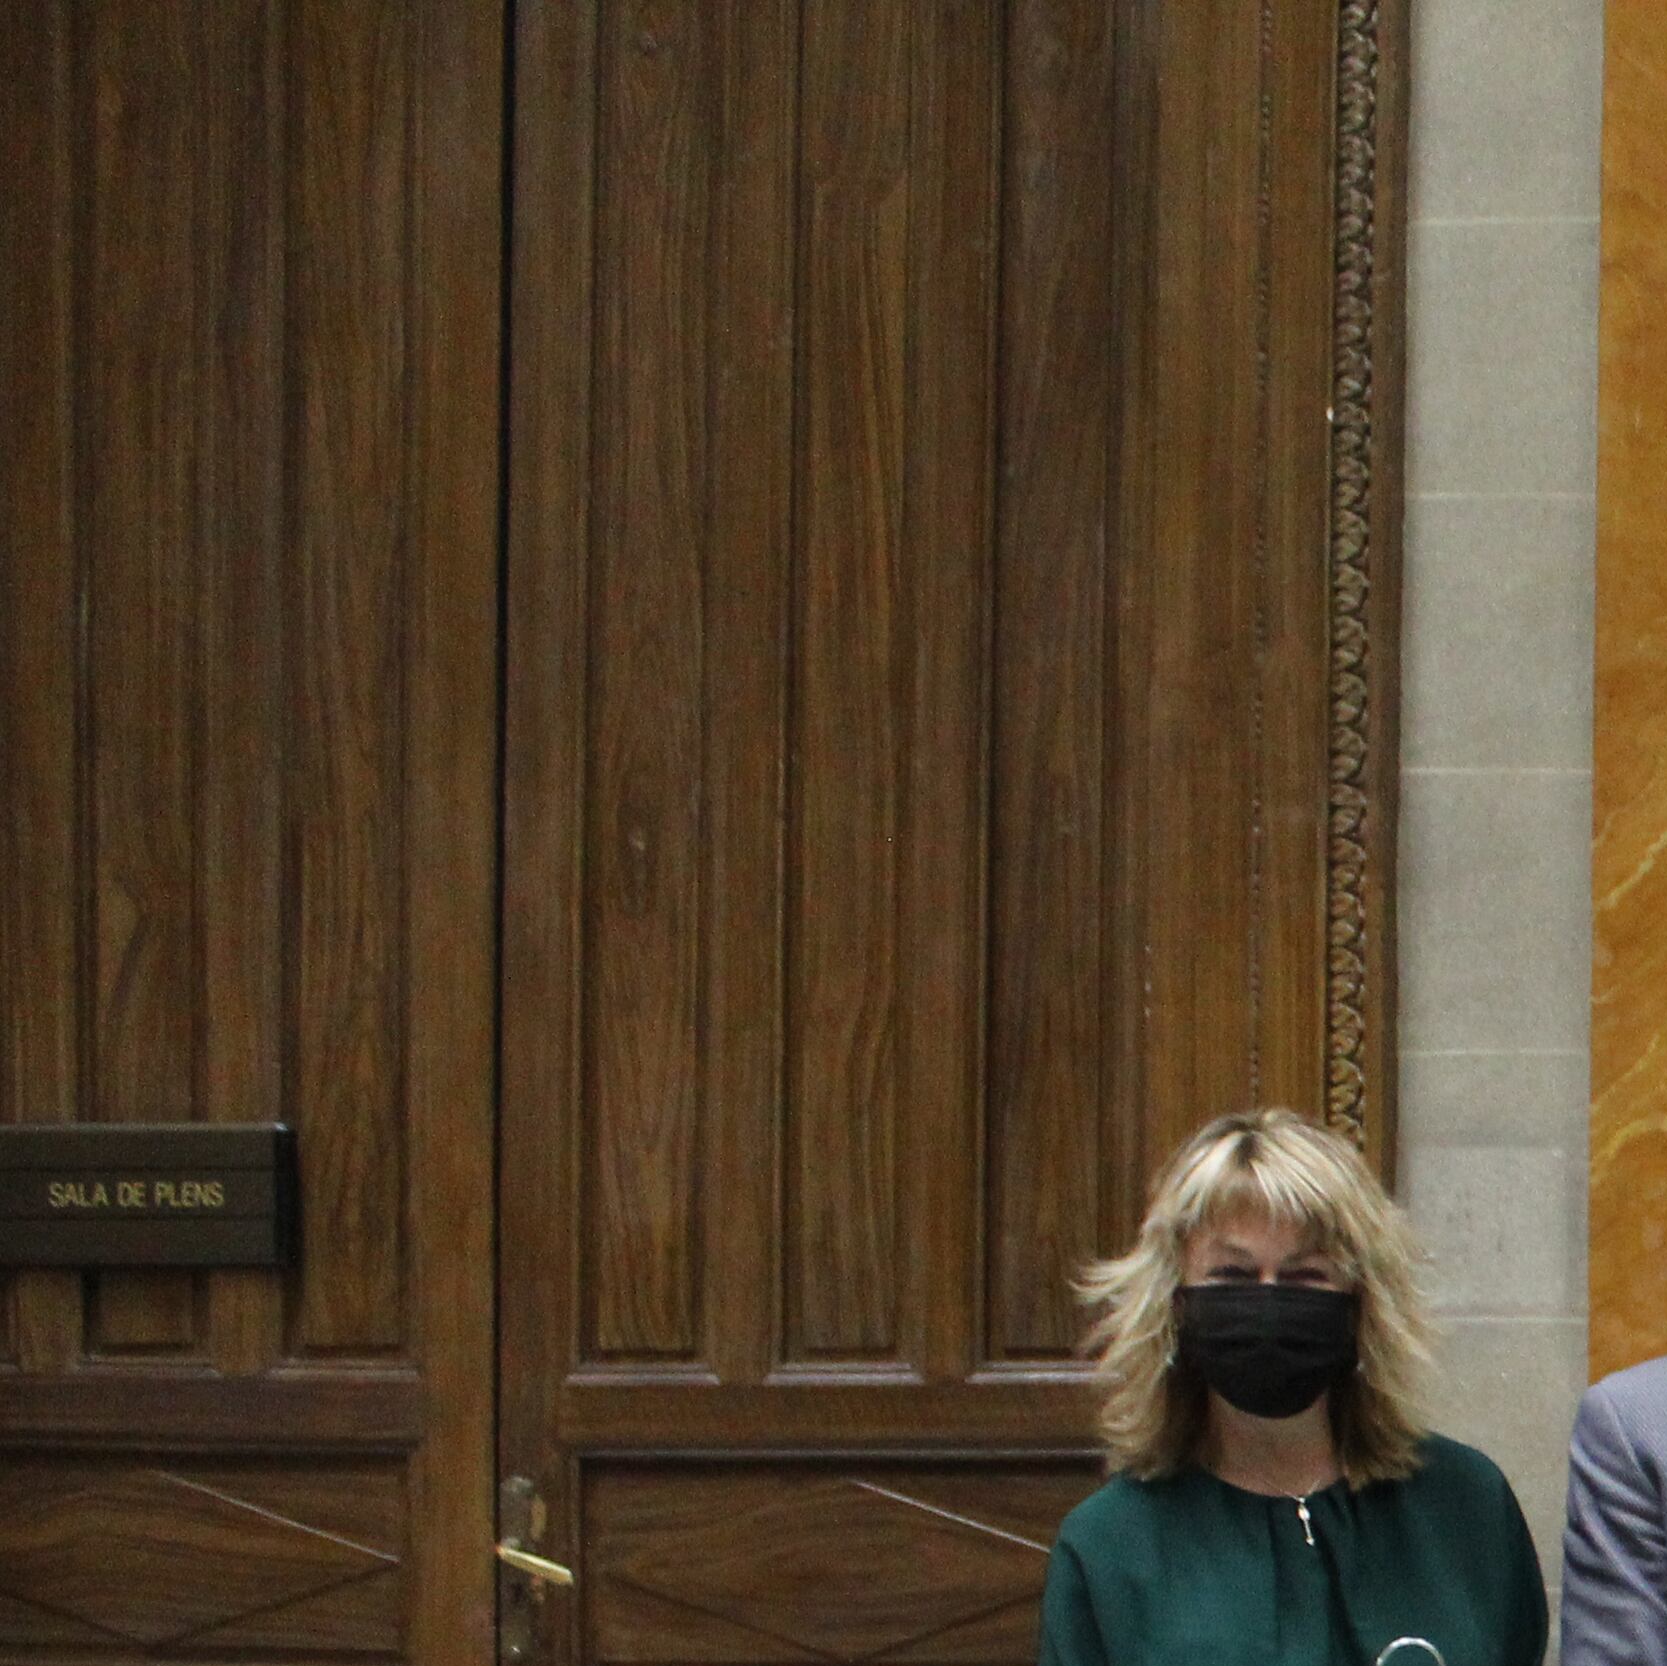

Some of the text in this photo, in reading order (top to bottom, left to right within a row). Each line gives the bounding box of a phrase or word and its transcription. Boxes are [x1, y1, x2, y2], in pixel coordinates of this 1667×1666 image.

[48, 1180, 225, 1208] SALA DE PLENS
